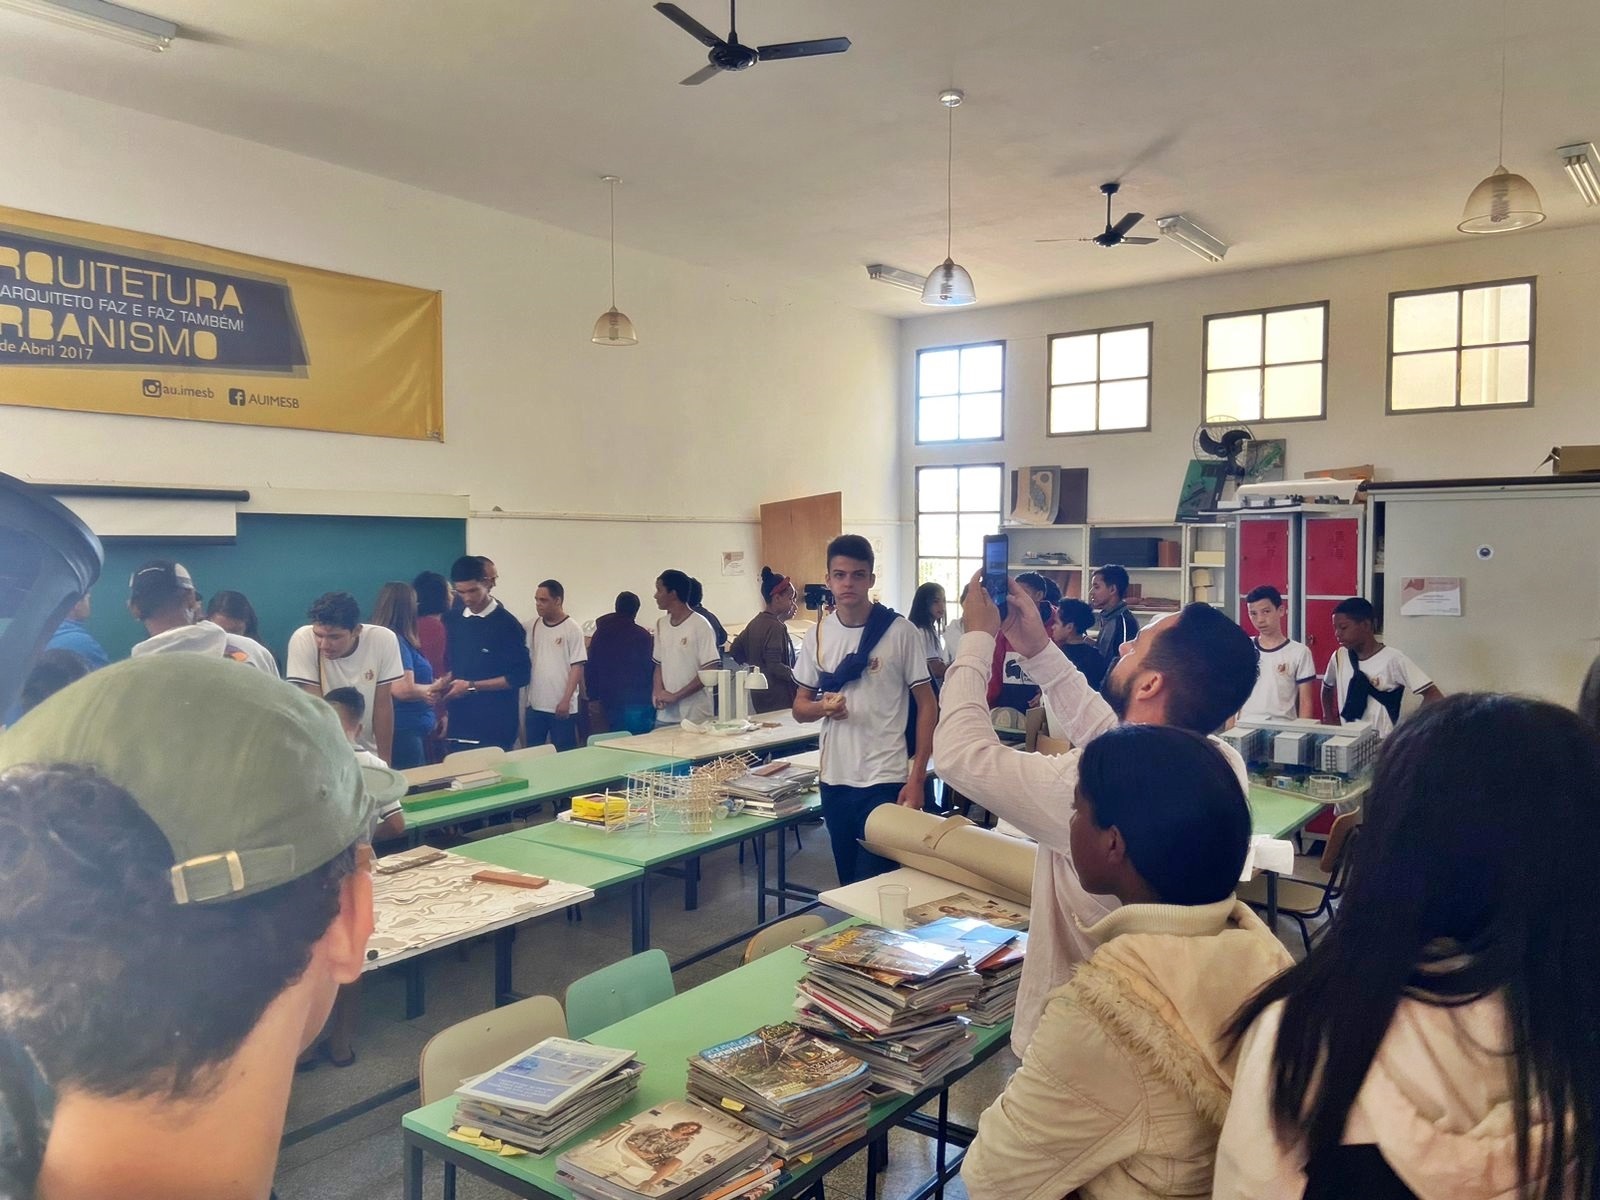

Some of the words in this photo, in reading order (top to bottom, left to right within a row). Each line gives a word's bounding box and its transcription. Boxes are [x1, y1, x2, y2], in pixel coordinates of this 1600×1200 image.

[0, 284, 94, 310] ARQUITETO
[99, 298, 128, 315] FAZ
[132, 304, 142, 317] E
[147, 306, 175, 321] FAZ
[179, 310, 244, 332] TAMBÉM!
[0, 339, 17, 353] de
[19, 341, 55, 356] Abril
[58, 345, 94, 360] 2017
[163, 384, 215, 399] au.imesb
[248, 393, 300, 409] AUIMESB
